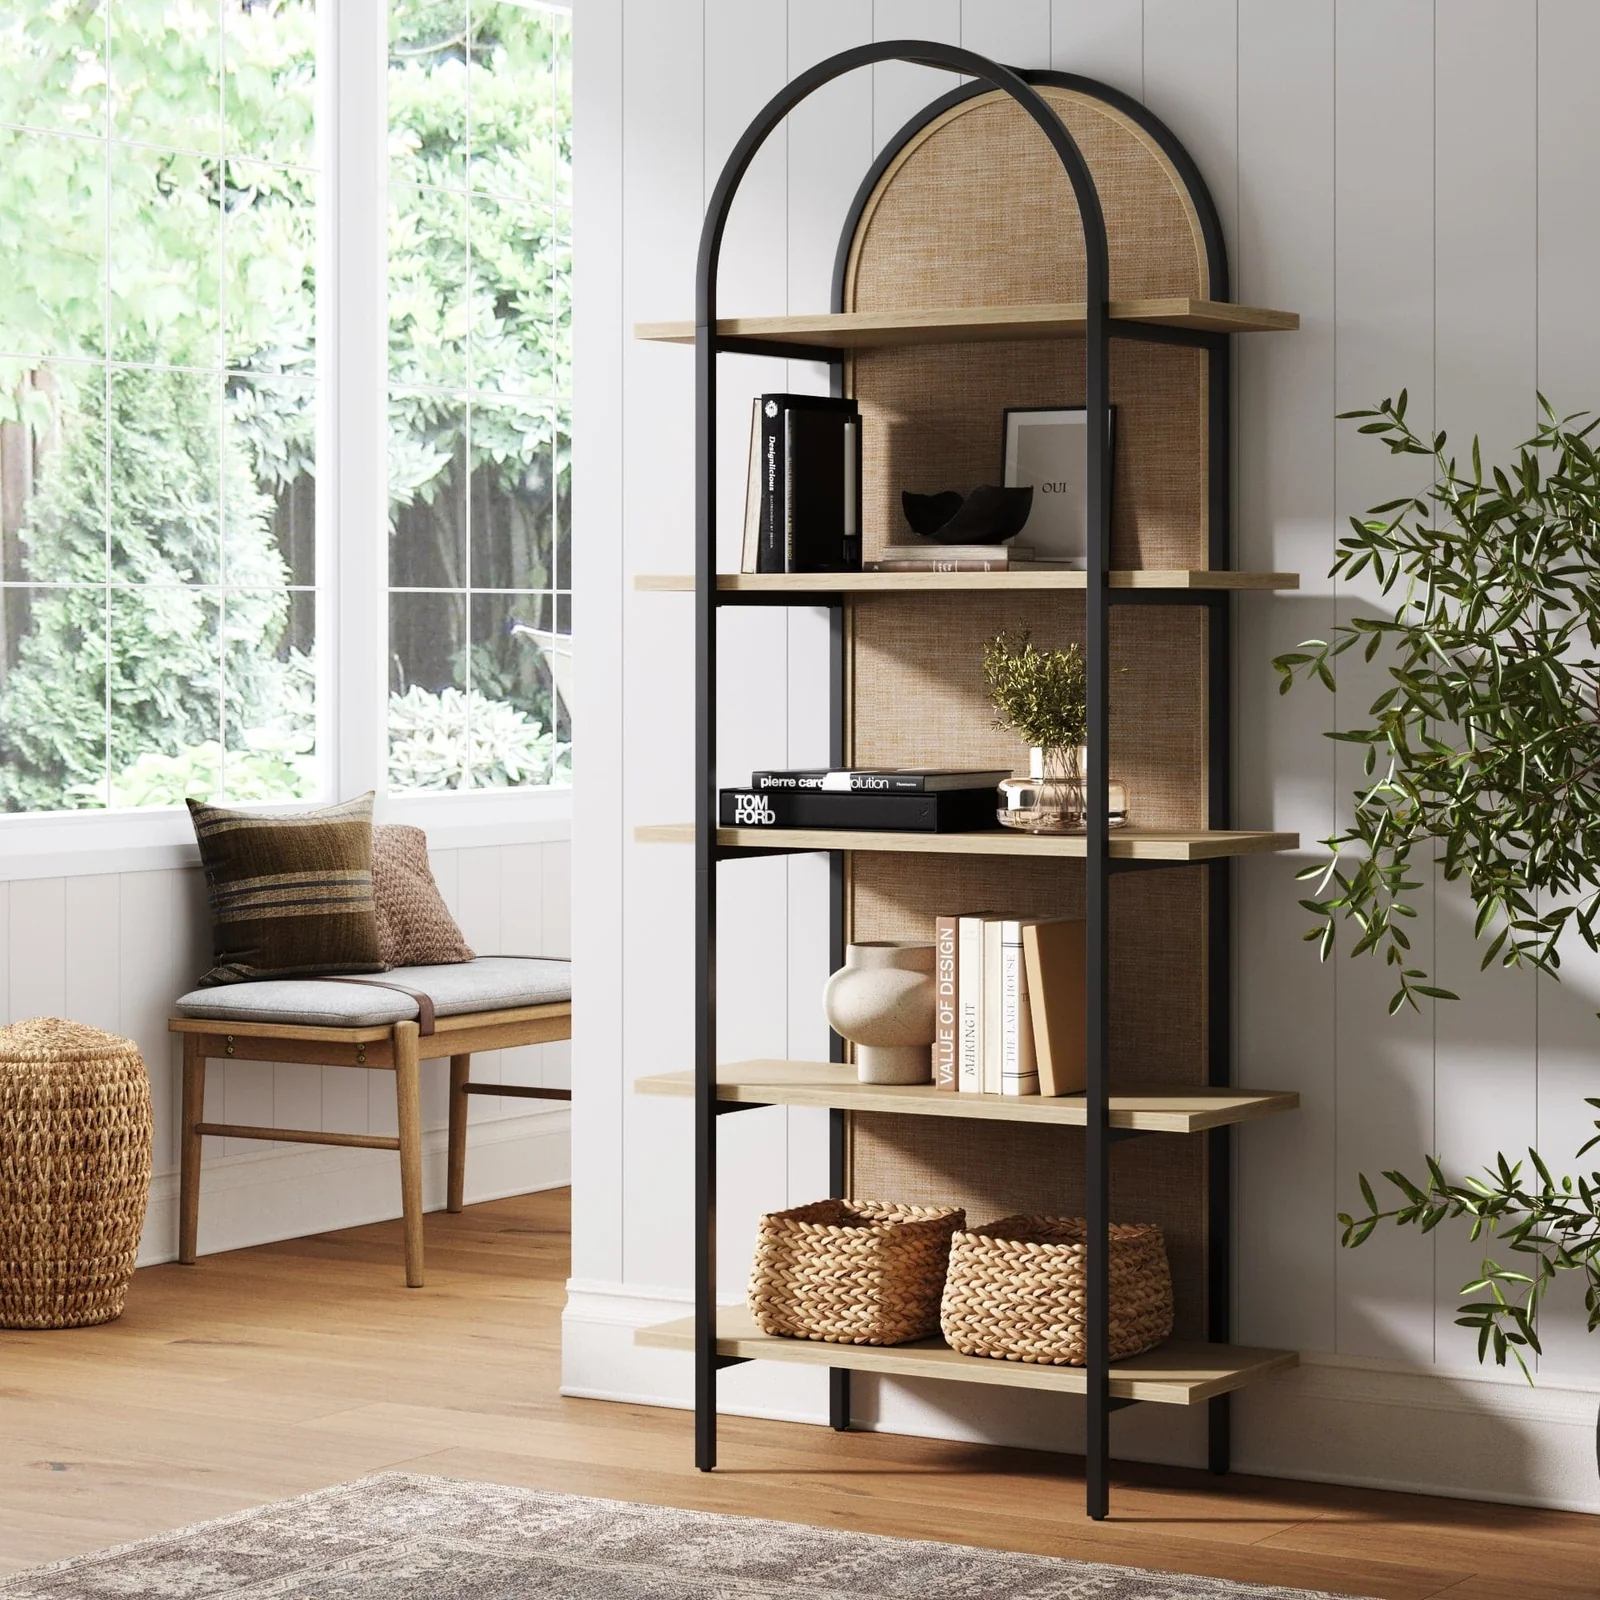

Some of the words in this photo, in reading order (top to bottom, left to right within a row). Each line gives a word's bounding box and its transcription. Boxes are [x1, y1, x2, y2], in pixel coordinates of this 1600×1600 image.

[767, 435, 776, 491] Designlicious
[1042, 482, 1067, 494] OUI
[760, 775, 796, 789] pierre
[798, 775, 828, 788] card
[850, 776, 889, 789] olution
[734, 794, 768, 810] TOM
[734, 809, 776, 824] FORD
[940, 928, 954, 995] DESIGN
[1006, 954, 1016, 998] HOUSE
[940, 1001, 954, 1024] OF
[964, 1002, 976, 1016] IT
[1006, 1001, 1016, 1033] LAKE
[940, 1029, 954, 1085] VALUE
[964, 1019, 976, 1076] MAKING
[1006, 1039, 1016, 1065] THE
